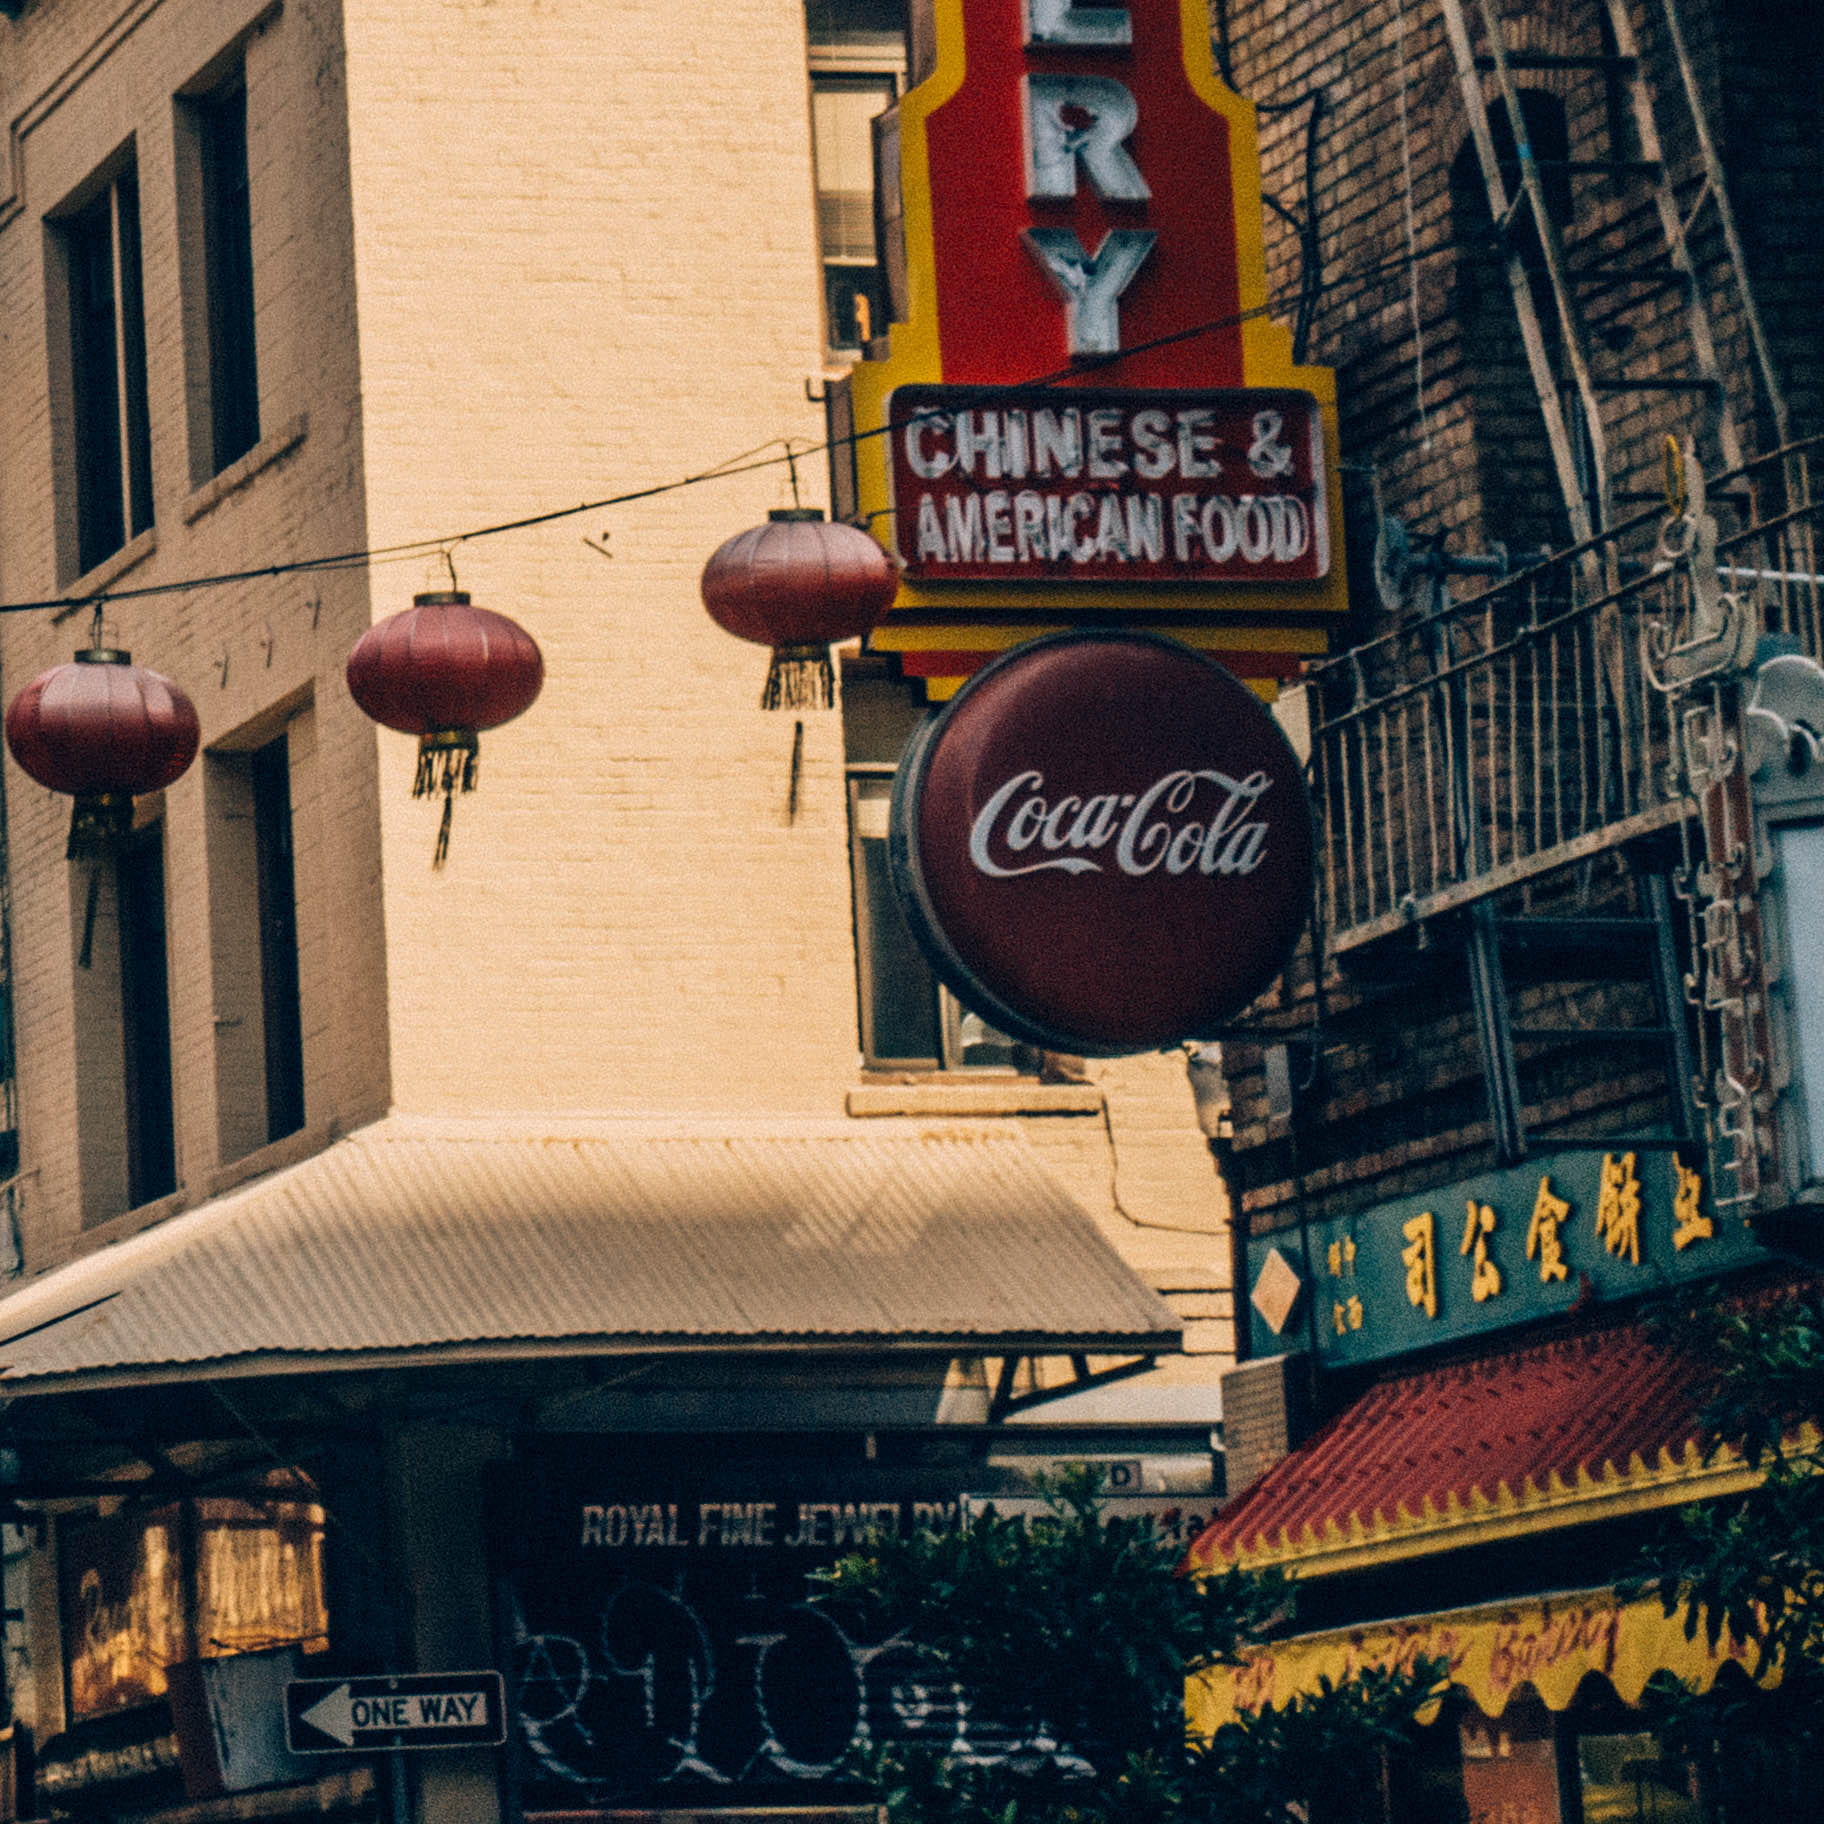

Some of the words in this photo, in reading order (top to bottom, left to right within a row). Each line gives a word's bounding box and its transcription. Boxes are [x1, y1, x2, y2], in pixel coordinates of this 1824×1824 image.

[904, 406, 1225, 479] CHINESE
[1248, 409, 1297, 478] &
[916, 489, 1163, 565] AMERICAN
[1172, 492, 1312, 566] FOOD
[969, 770, 1273, 877] Coca-Cola
[582, 1504, 689, 1546] ROYAL
[699, 1503, 776, 1546] FINE
[355, 1698, 411, 1727] ONE
[419, 1695, 480, 1722] WAY
